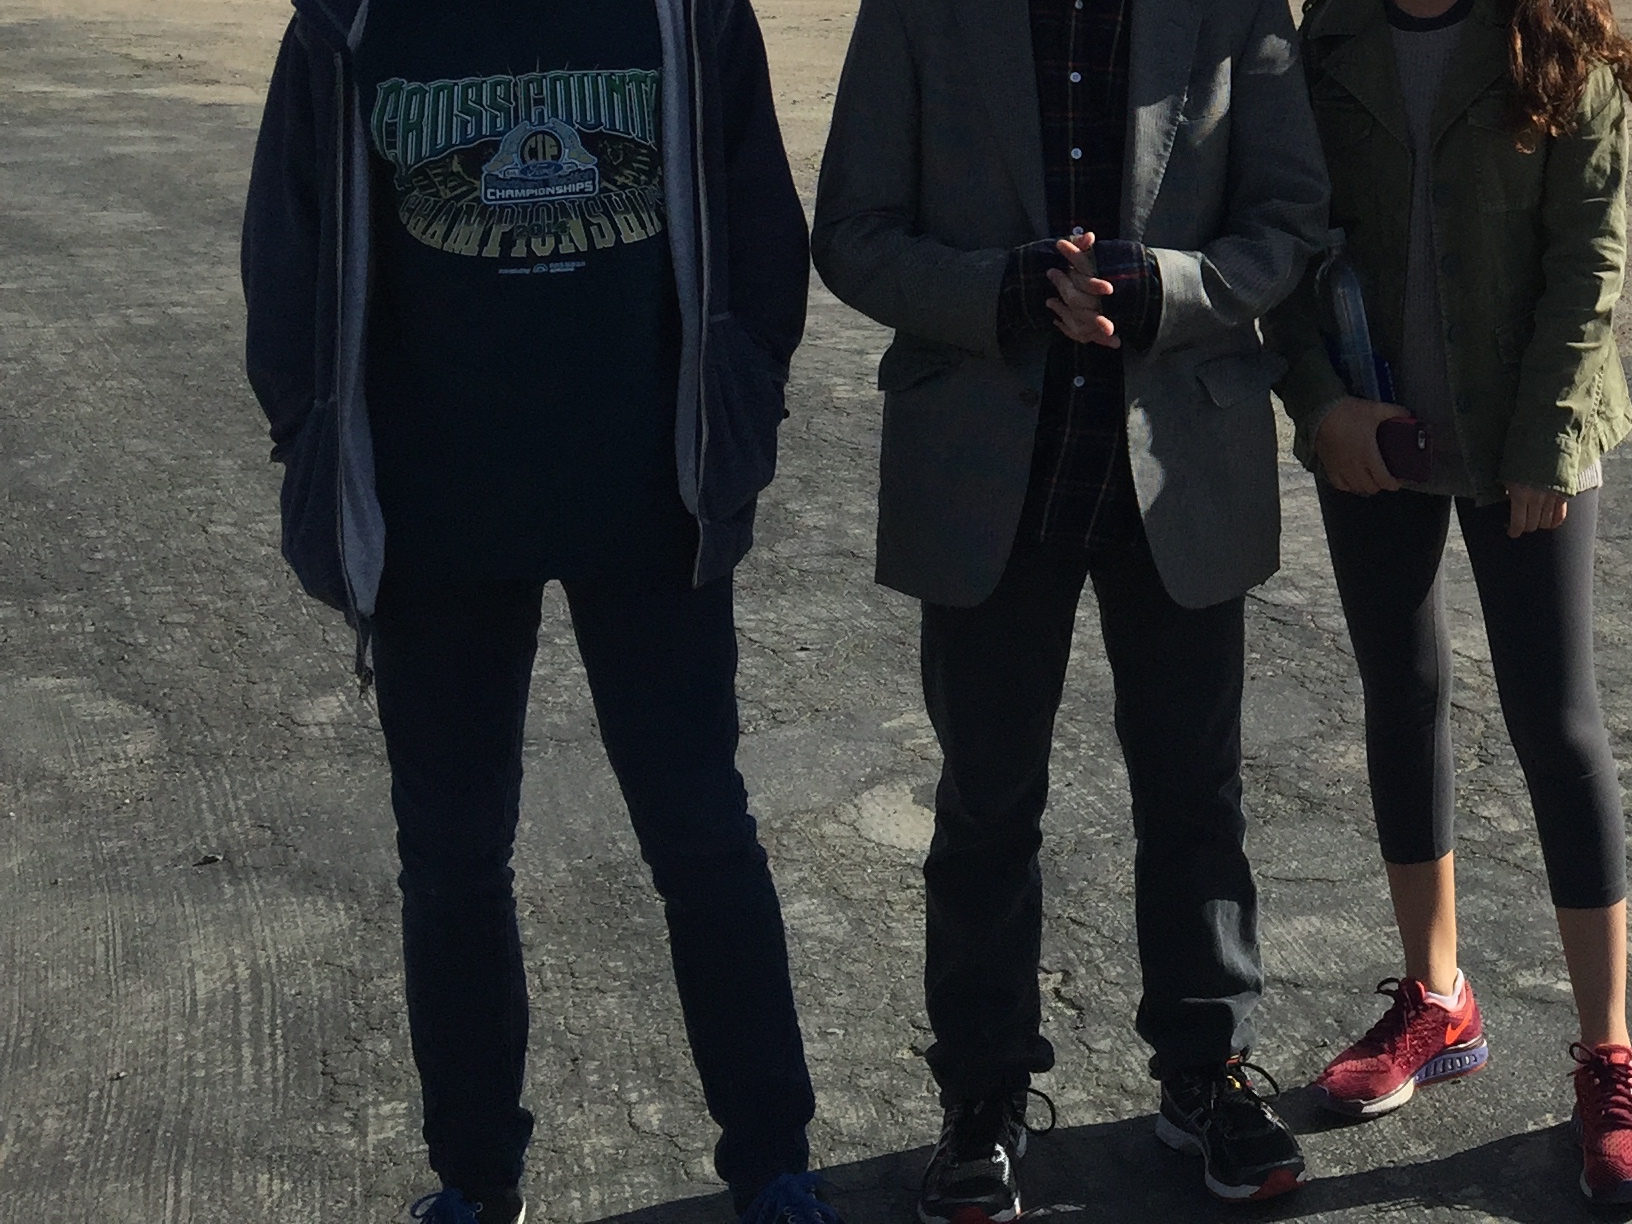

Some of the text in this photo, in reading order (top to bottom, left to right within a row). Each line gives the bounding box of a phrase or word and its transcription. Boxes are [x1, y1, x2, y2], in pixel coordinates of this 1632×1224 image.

[371, 68, 659, 173] CROSS COUNT
[486, 180, 594, 200] CHAMPIONSHIPS
